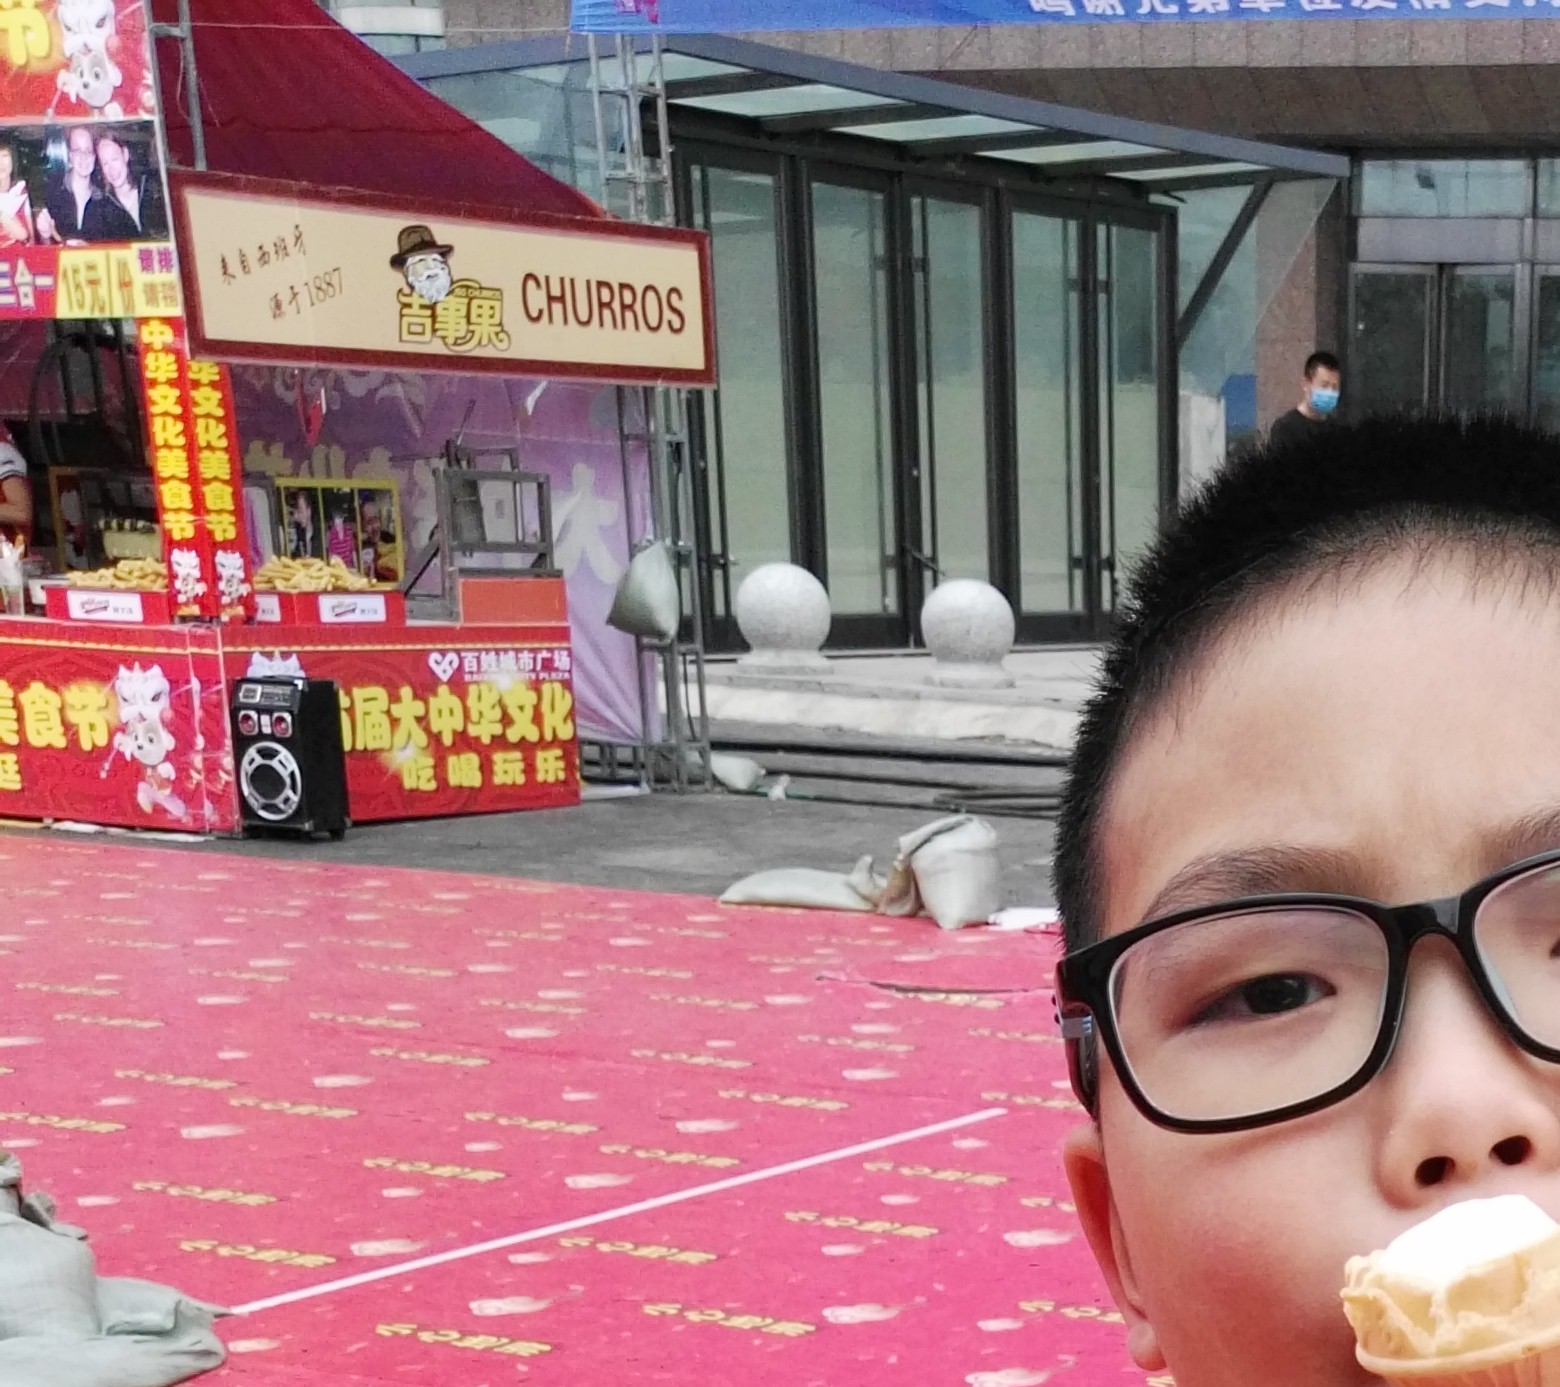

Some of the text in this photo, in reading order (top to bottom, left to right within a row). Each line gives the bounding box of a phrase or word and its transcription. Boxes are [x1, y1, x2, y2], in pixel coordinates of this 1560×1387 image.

[397, 290, 512, 352] 吉事果
[520, 272, 687, 335] CHURROS
[140, 318, 196, 541] 中华文化美食节
[461, 651, 571, 673] 百姓城市广场
